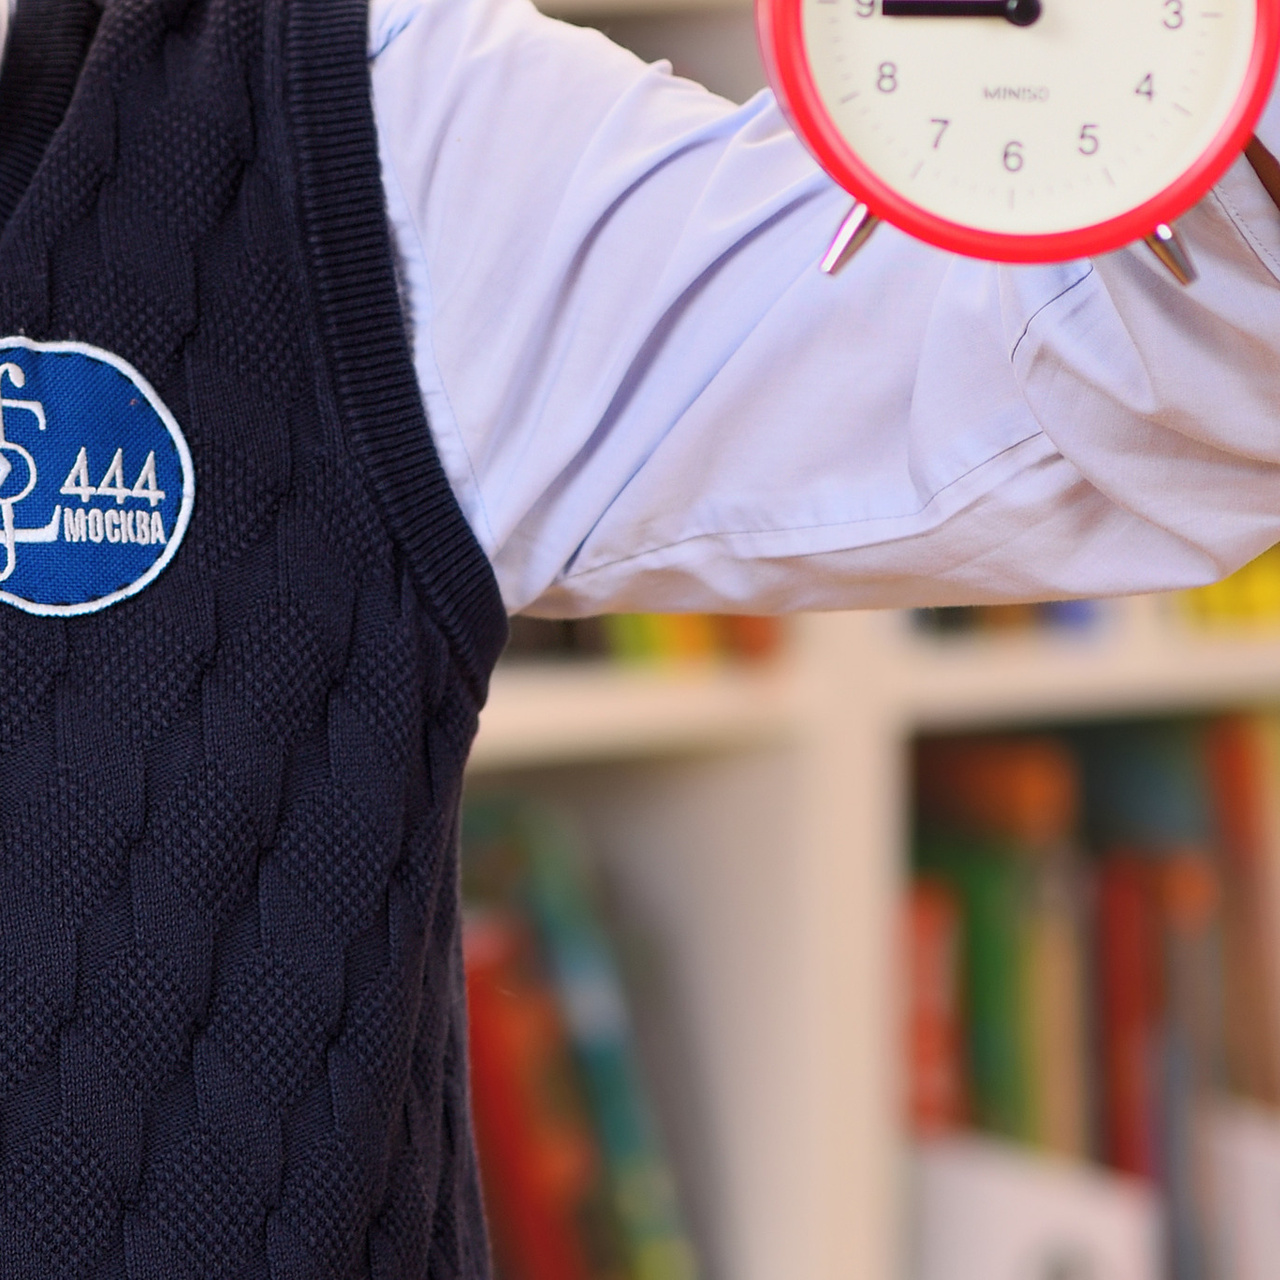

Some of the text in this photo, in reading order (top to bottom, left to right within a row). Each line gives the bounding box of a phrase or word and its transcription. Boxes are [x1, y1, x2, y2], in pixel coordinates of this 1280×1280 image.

[875, 61, 898, 94] 8
[981, 85, 1051, 103] MINISO
[1134, 72, 1155, 101] 4
[930, 118, 951, 150] 7
[1078, 123, 1100, 156] 5
[1002, 140, 1024, 173] 6
[60, 447, 166, 507] 444
[64, 507, 167, 545] МОСКВА
